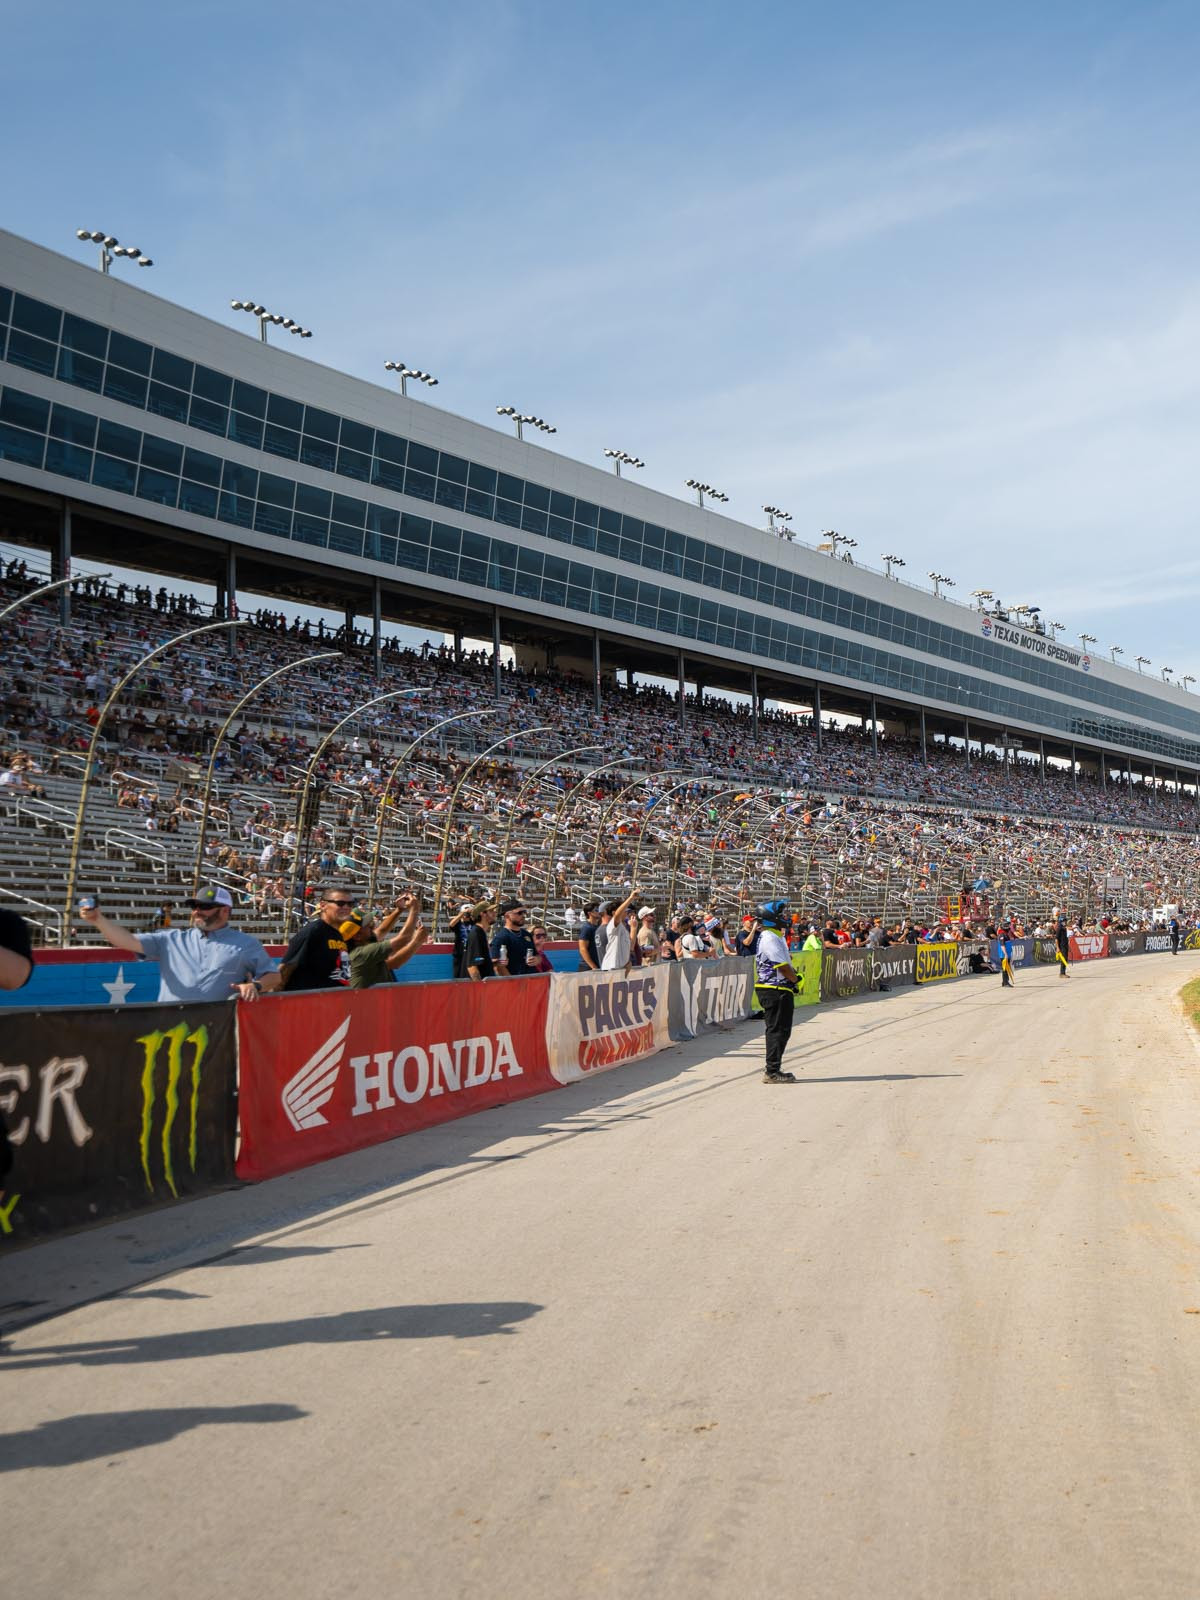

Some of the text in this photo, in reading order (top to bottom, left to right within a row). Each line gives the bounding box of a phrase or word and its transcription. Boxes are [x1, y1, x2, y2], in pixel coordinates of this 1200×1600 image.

[994, 624, 1082, 667] TEXAS MOTOR SPEEDWAY
[836, 956, 866, 982] MONSTER
[918, 948, 957, 979] SUZUKI
[578, 977, 657, 1036] PARTS
[704, 973, 748, 1024] THOR
[349, 1031, 523, 1116] HONDA
